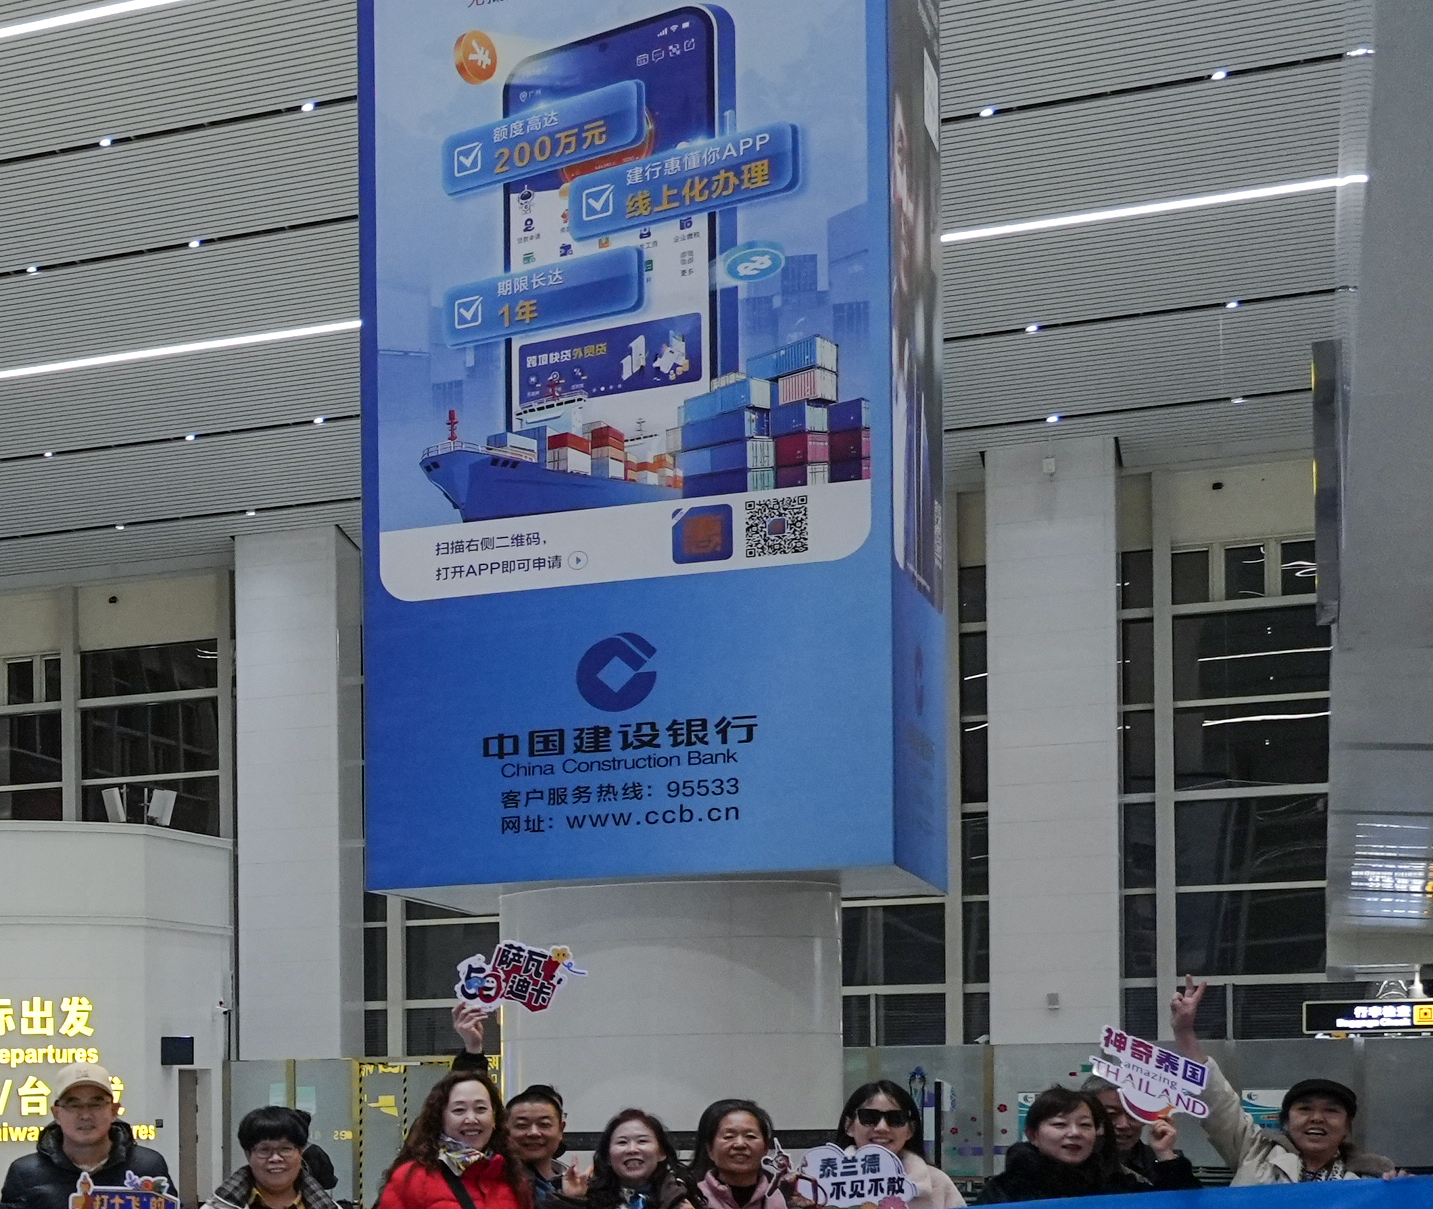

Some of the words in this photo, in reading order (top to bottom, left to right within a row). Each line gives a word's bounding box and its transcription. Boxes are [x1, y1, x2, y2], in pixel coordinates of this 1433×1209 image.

[492, 111, 559, 143] 额度高达
[493, 120, 607, 175] 200万元
[626, 133, 771, 187] 建行惠懂你APP
[625, 159, 772, 219] 线上化办理
[496, 268, 564, 297] 期限长达
[498, 299, 539, 328] 1年
[435, 532, 548, 556] 扫描右侧二维码，
[435, 554, 562, 581] 打开APP即可申请
[482, 715, 759, 760] 中国建设银行
[500, 760, 555, 779] China
[562, 752, 681, 774] Construction
[687, 749, 739, 767] Bank
[496, 943, 548, 979] 萨瓦
[505, 975, 552, 1006] 迪卡
[1103, 1026, 1207, 1088] 神奇泰国
[1092, 1057, 1207, 1116] THAILAND
[1124, 1061, 1178, 1090] amazing
[819, 1153, 881, 1179] 泰兰德
[829, 1176, 905, 1200] 不见不散
